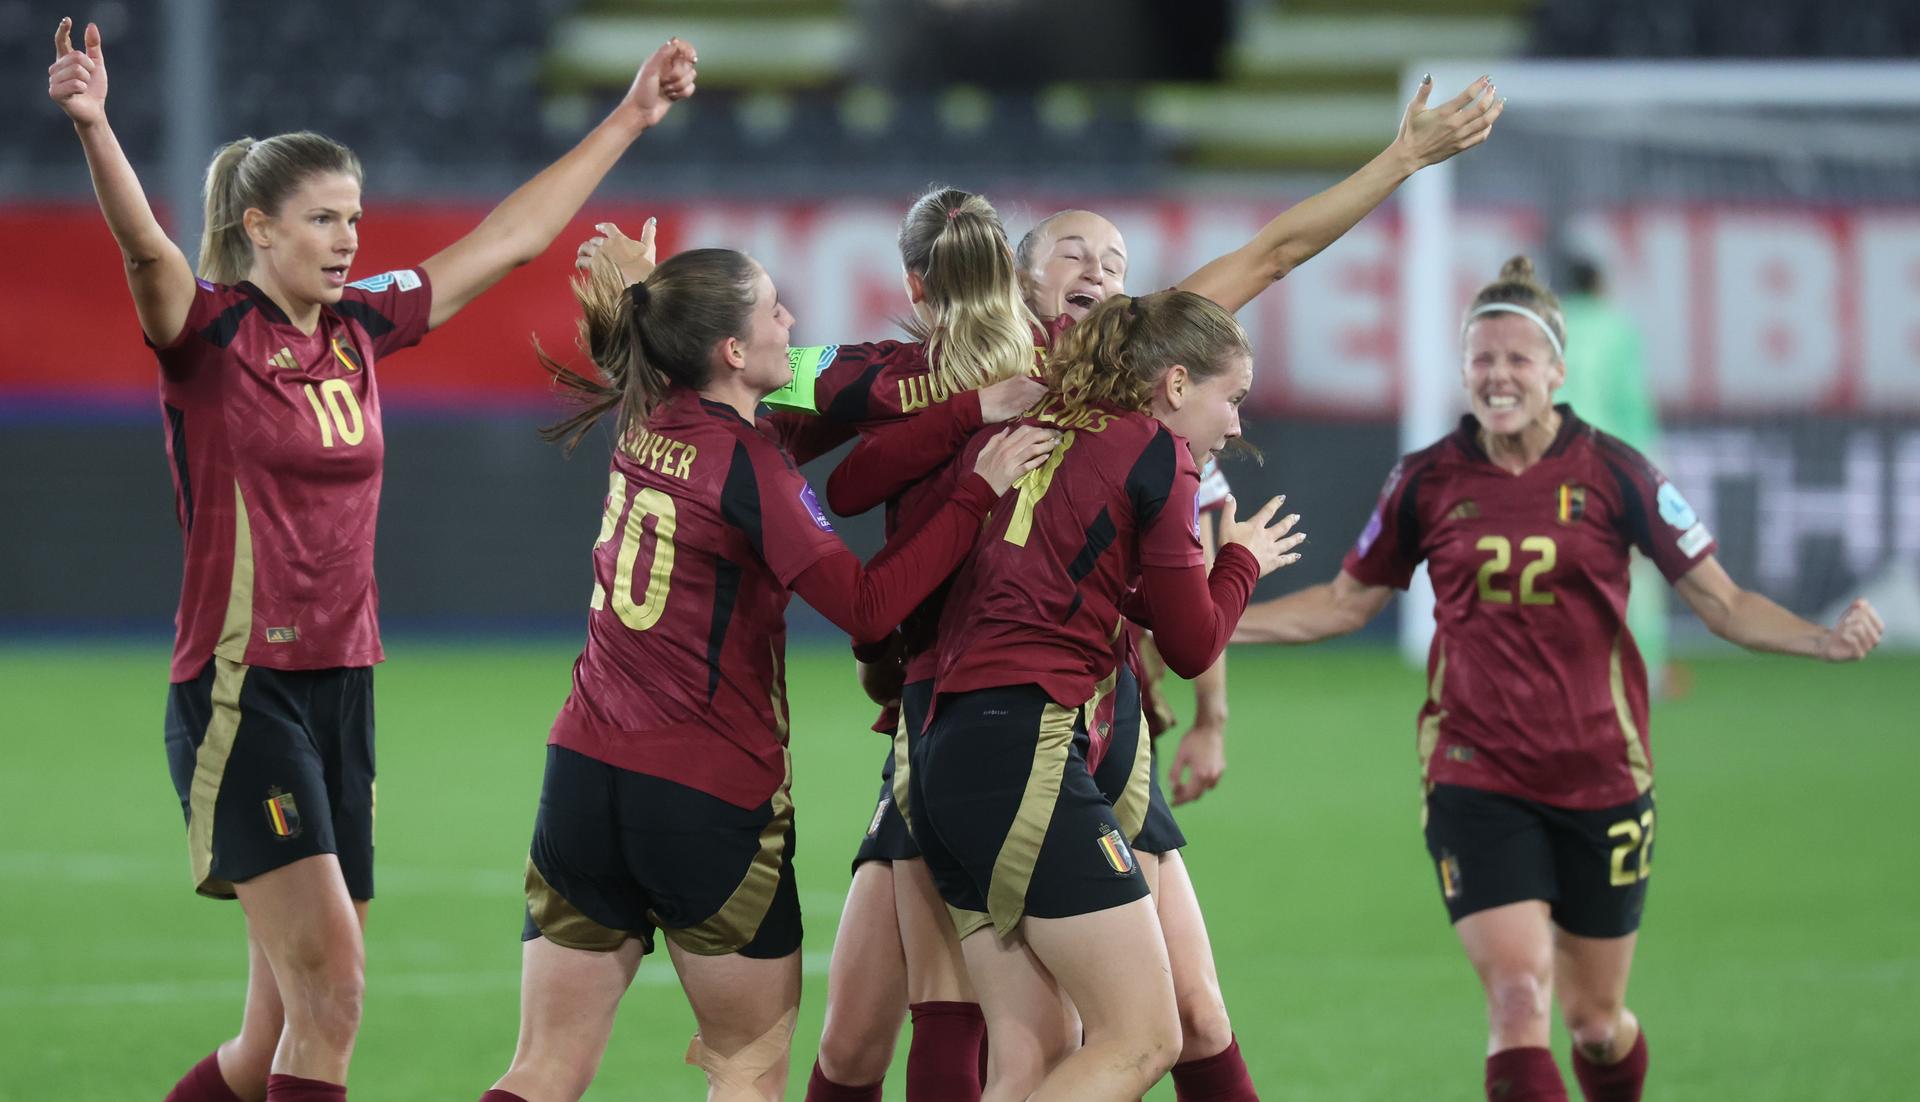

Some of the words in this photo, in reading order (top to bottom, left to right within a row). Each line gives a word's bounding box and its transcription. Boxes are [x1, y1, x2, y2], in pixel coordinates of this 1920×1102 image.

[303, 378, 365, 447] 10
[590, 470, 677, 631] 20
[1476, 535, 1557, 605] 22
[1607, 809, 1655, 887] 22
